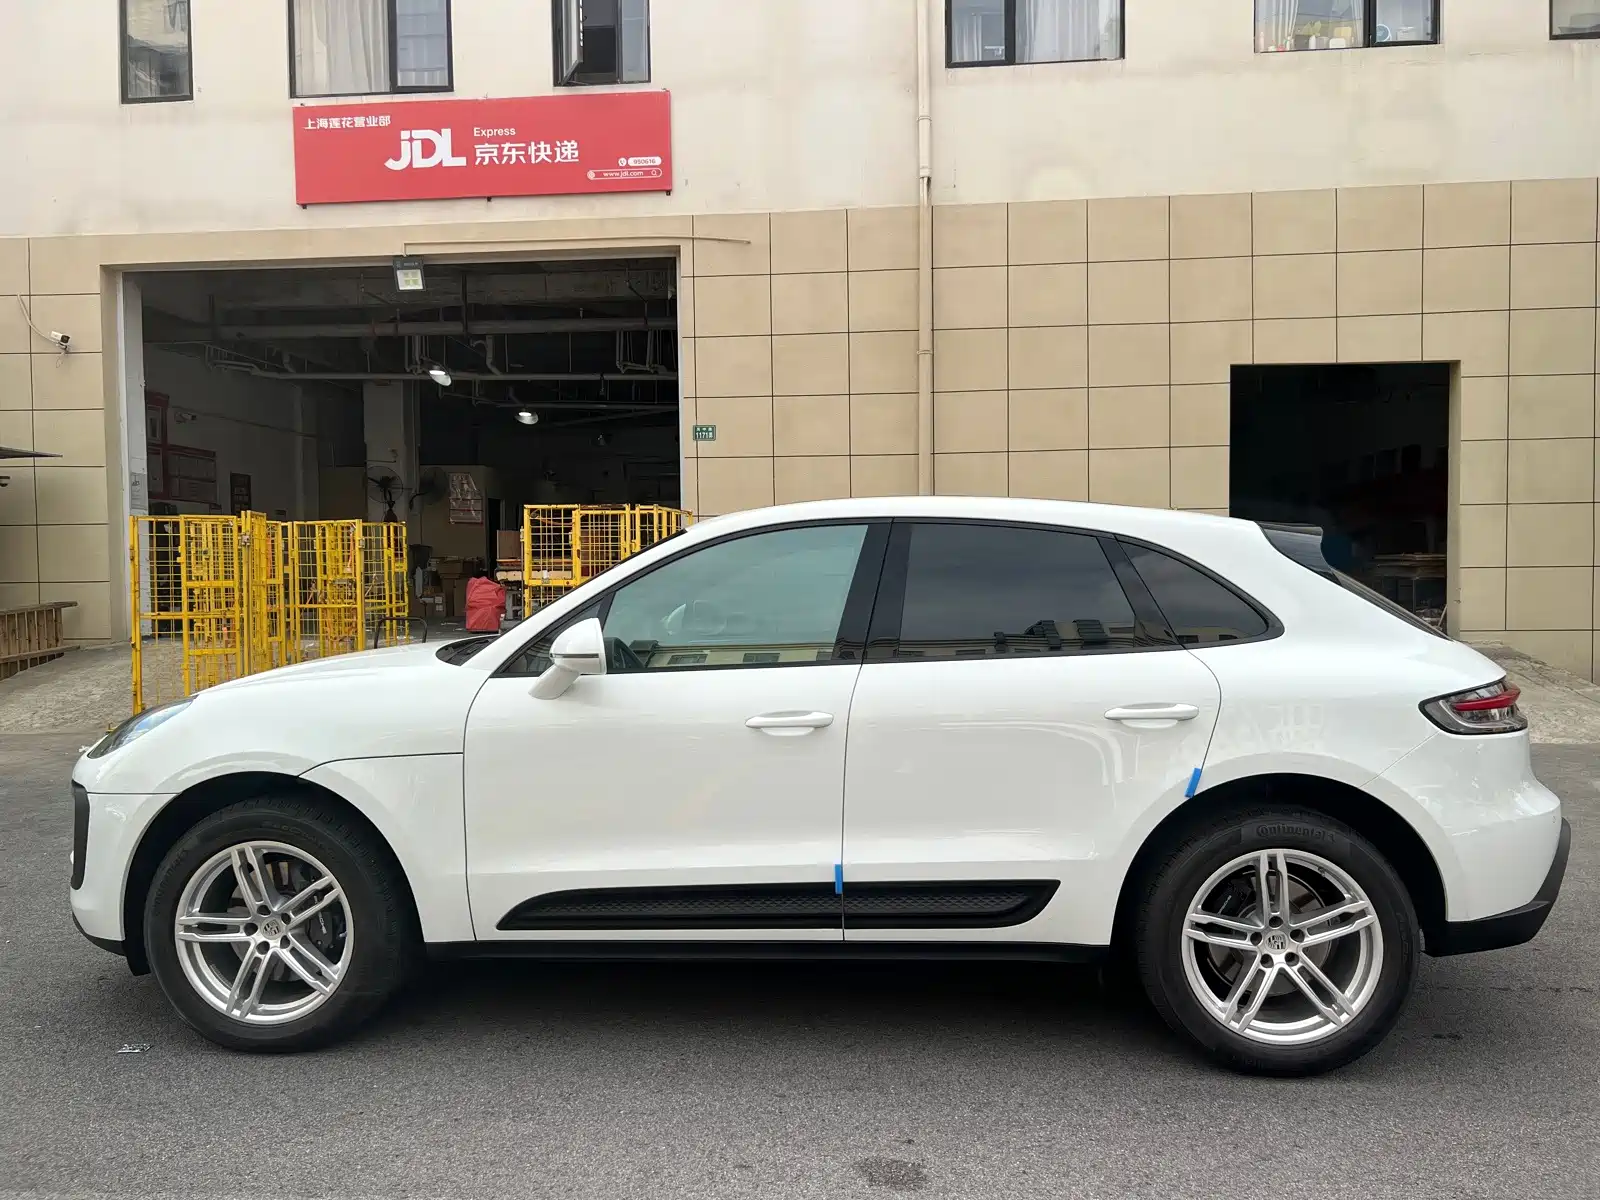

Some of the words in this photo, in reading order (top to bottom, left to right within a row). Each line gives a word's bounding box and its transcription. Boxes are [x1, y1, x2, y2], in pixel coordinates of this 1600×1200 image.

[304, 115, 391, 130] 上海莲花营业部
[473, 127, 517, 139] Express
[474, 140, 580, 166] 京东快递
[602, 170, 644, 178] www.jdl.com
[1256, 824, 1326, 839] Continental
